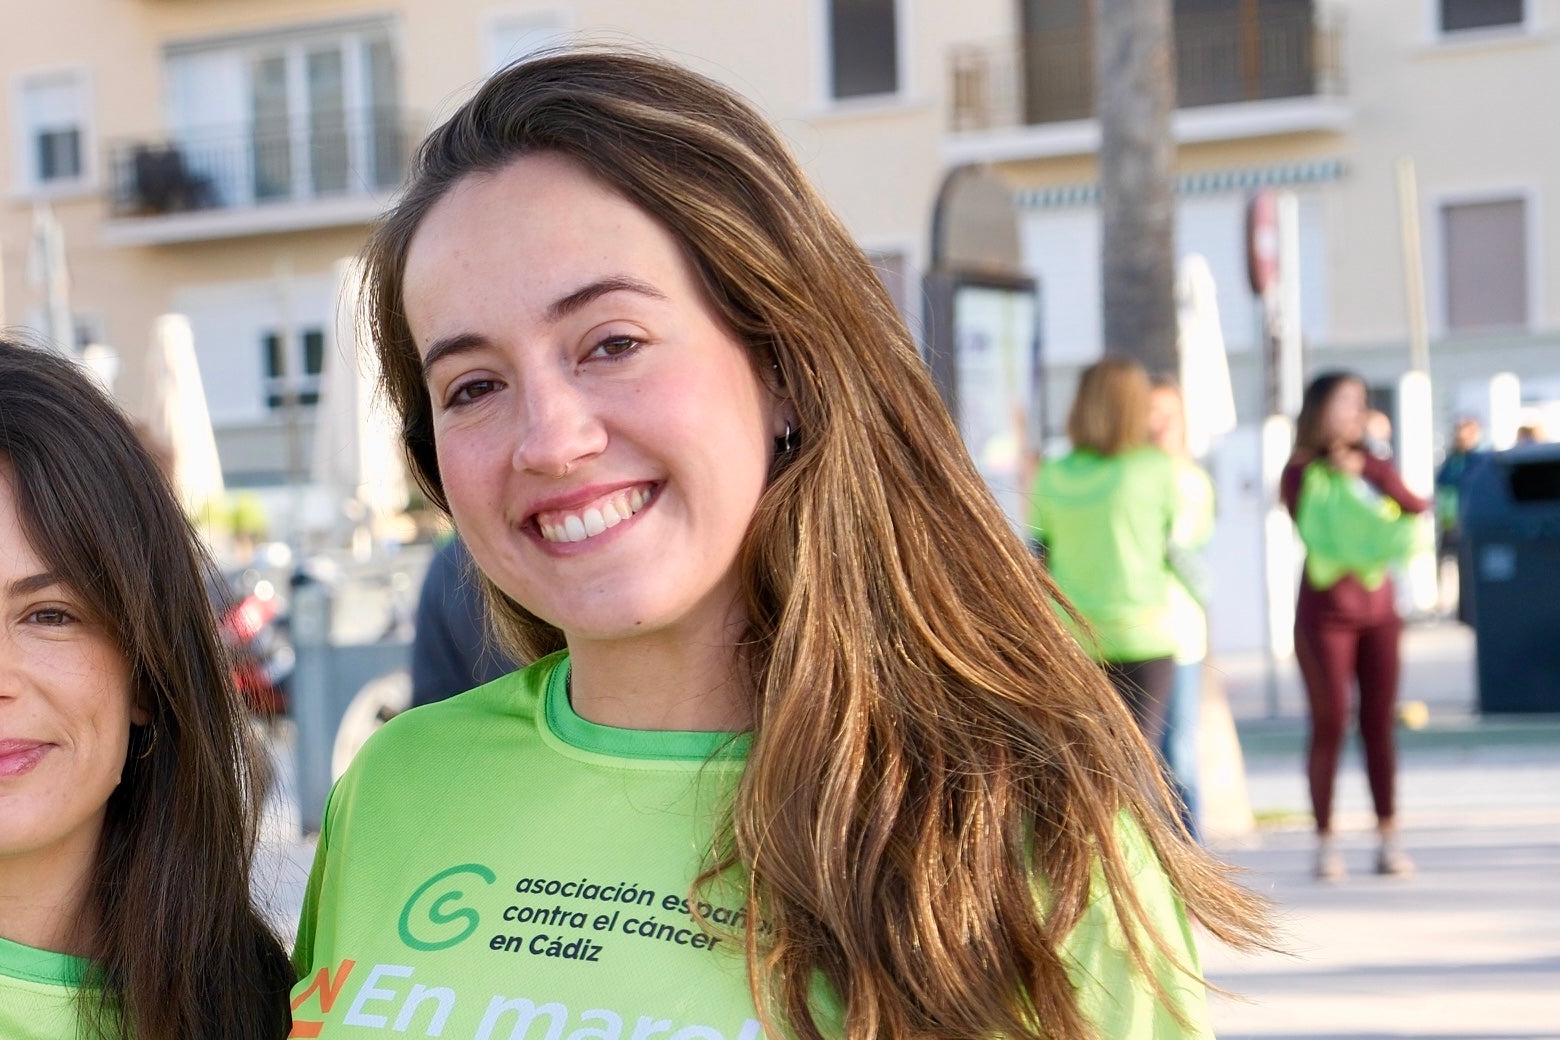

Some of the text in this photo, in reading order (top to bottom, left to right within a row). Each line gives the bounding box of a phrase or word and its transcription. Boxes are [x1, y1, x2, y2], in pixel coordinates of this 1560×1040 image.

[516, 877, 656, 907] asociación
[503, 905, 723, 952] contra el cáncer
[489, 934, 603, 962] en Cádiz
[343, 964, 456, 1037] En
